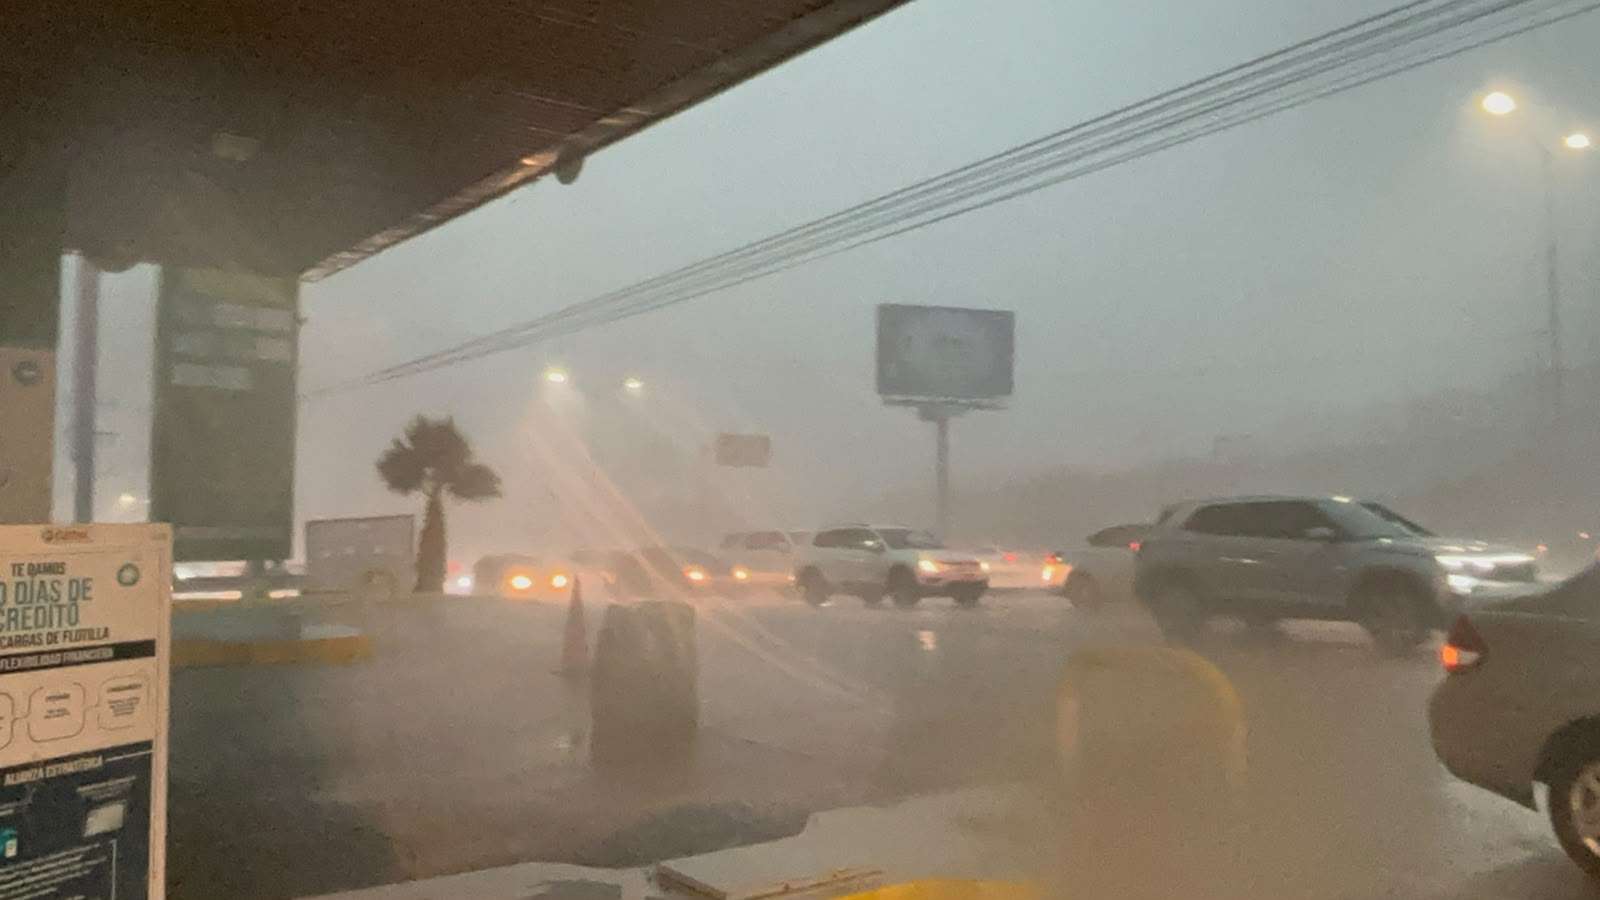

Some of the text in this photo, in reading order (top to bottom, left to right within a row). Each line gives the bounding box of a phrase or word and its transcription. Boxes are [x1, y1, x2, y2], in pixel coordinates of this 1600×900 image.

[11, 562, 66, 577] TE DAMOS
[68, 578, 93, 601] DE
[46, 631, 59, 646] DE
[63, 627, 109, 643] FLOTILLA
